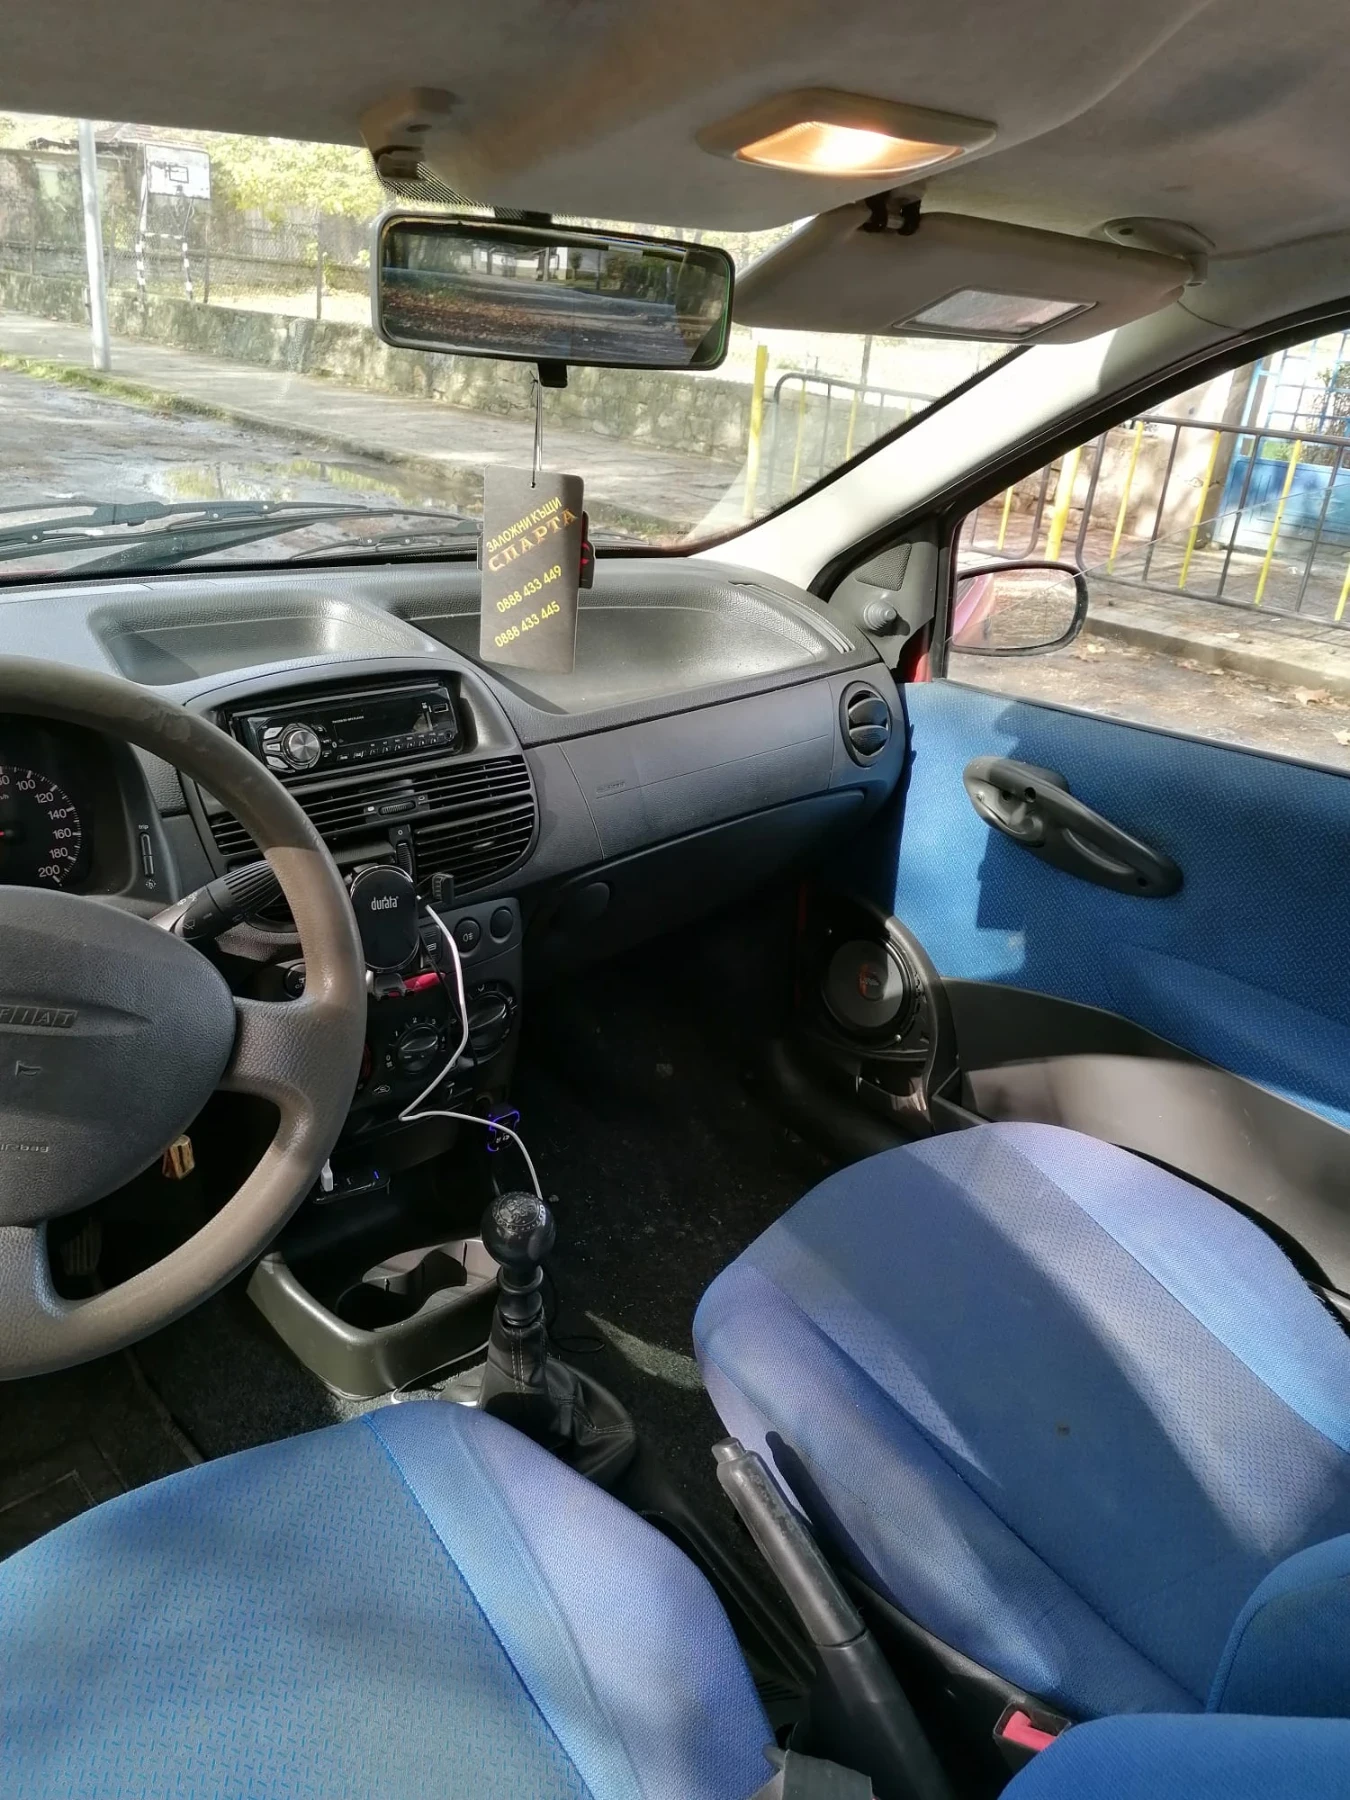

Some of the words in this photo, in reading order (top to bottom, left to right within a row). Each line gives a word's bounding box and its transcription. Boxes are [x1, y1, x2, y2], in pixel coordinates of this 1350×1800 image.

[486, 516, 532, 553] ЗАЛОЖНИ
[531, 496, 562, 523] КЪЩИ
[488, 508, 578, 572] СПАРТА
[496, 591, 523, 613] 0888
[523, 578, 543, 599] 433
[543, 565, 563, 584] 449
[494, 625, 521, 648] 0888
[521, 613, 540, 632] 433
[541, 601, 561, 620] 445
[15, 779, 36, 791] 100
[34, 792, 54, 804] 120
[48, 808, 67, 820] 140
[53, 827, 72, 840] 160
[49, 847, 68, 860] 180
[38, 864, 61, 878] 200
[371, 896, 398, 912] durata
[0, 1007, 73, 1025] FIAT
